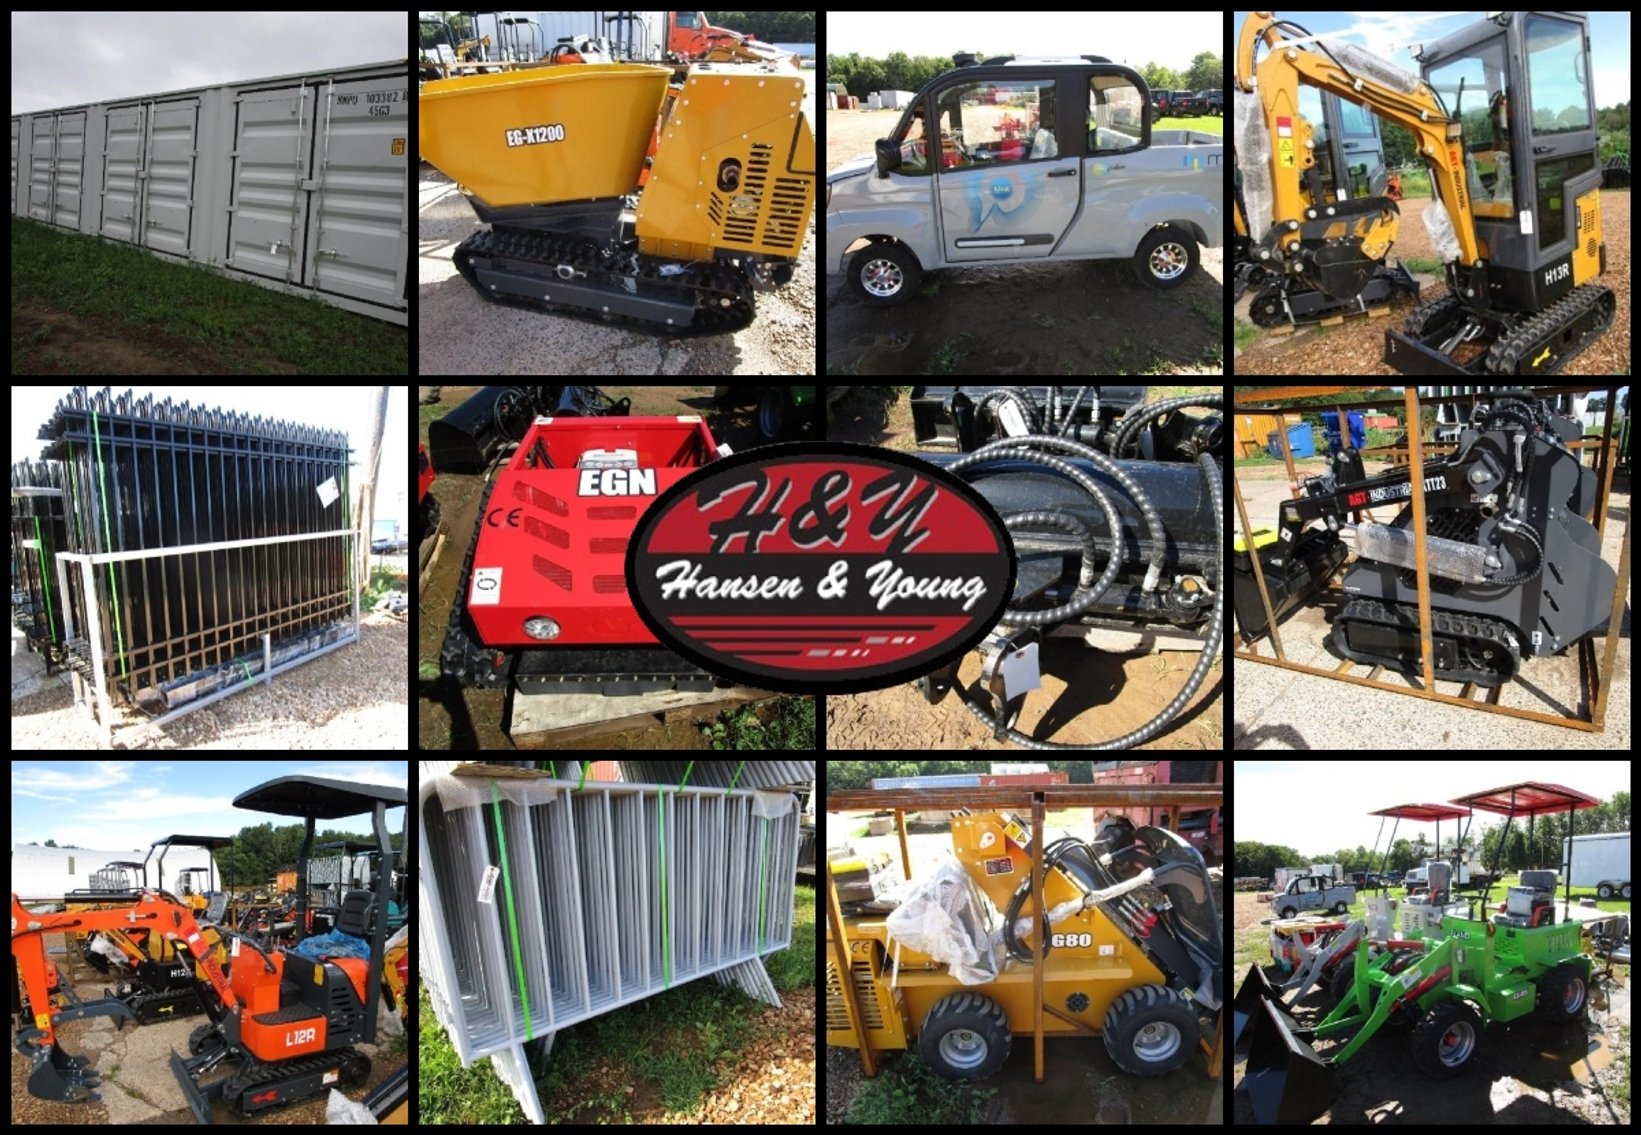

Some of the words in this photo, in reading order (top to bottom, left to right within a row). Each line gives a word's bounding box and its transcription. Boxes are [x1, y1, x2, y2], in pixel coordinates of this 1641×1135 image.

[505, 124, 565, 148] EG-X1200
[1545, 263, 1570, 287] H13R
[577, 468, 658, 497] EGN
[285, 1027, 316, 1048] L12R
